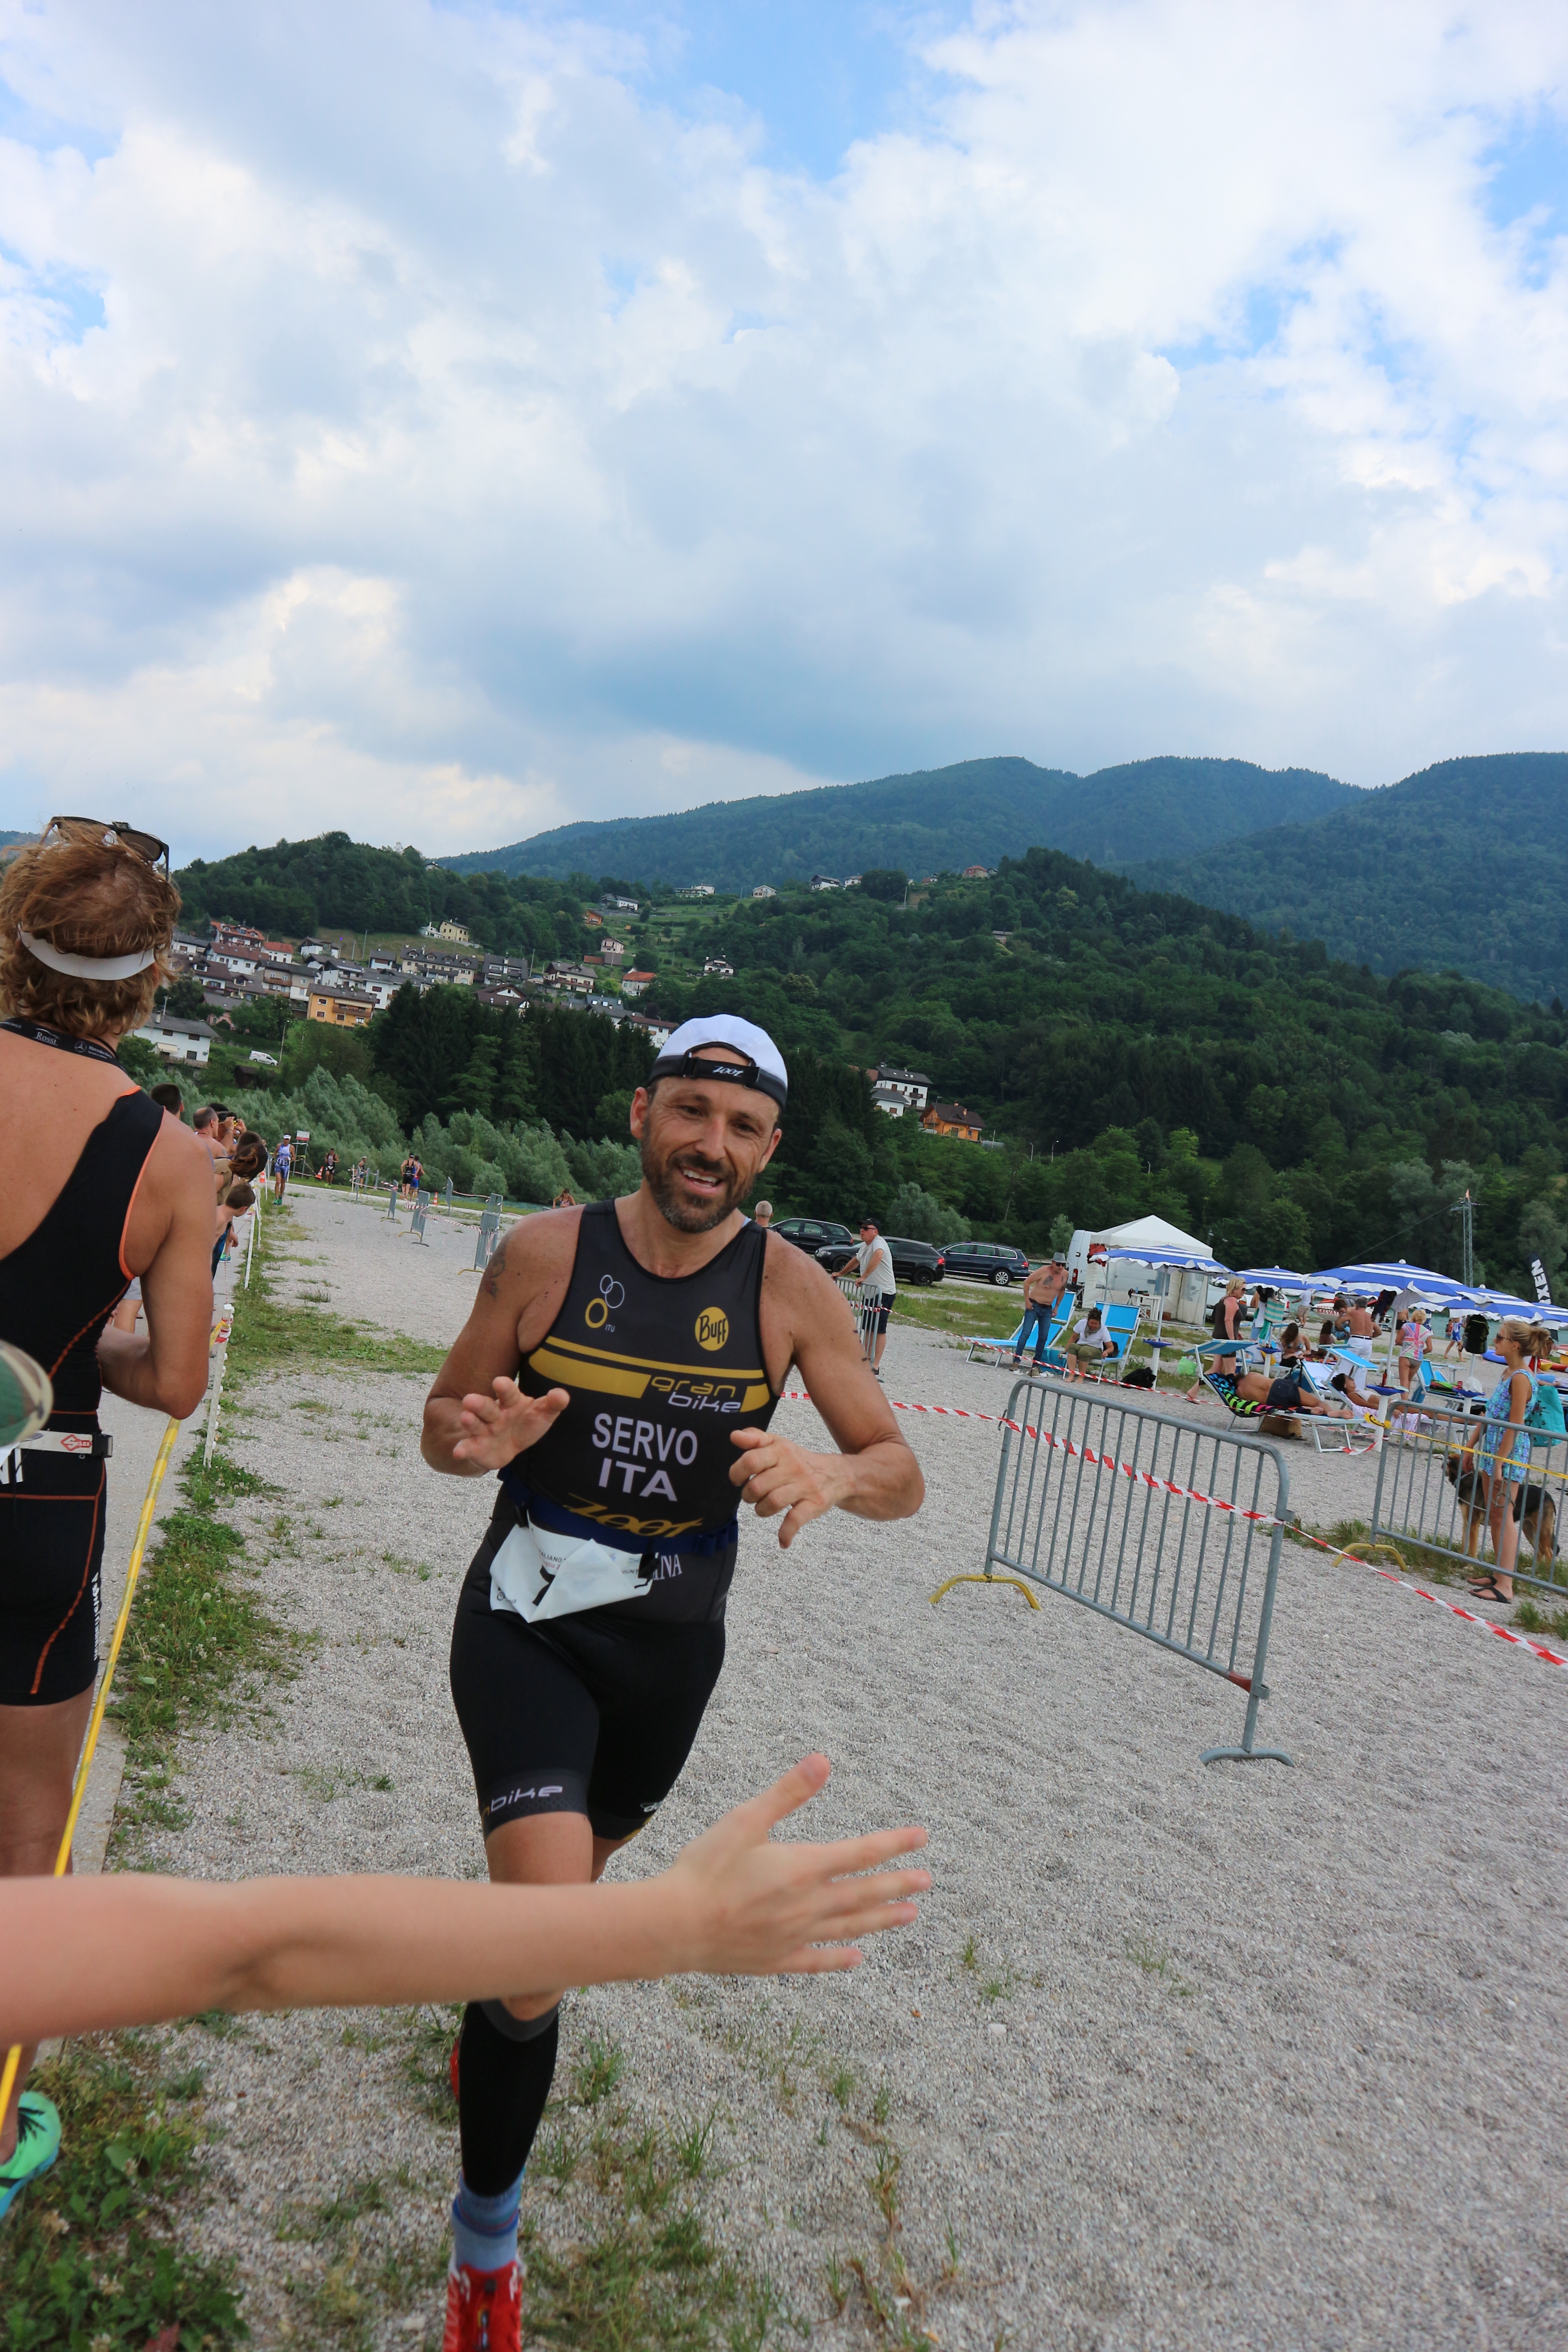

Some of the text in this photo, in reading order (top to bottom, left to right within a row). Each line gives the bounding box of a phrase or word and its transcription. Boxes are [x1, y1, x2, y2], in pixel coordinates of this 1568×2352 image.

[605, 1324, 616, 1333] ITU
[651, 1377, 736, 1398] gran
[668, 1391, 741, 1413] bike
[592, 1413, 698, 1466] SERVO
[598, 1457, 678, 1502] ITA
